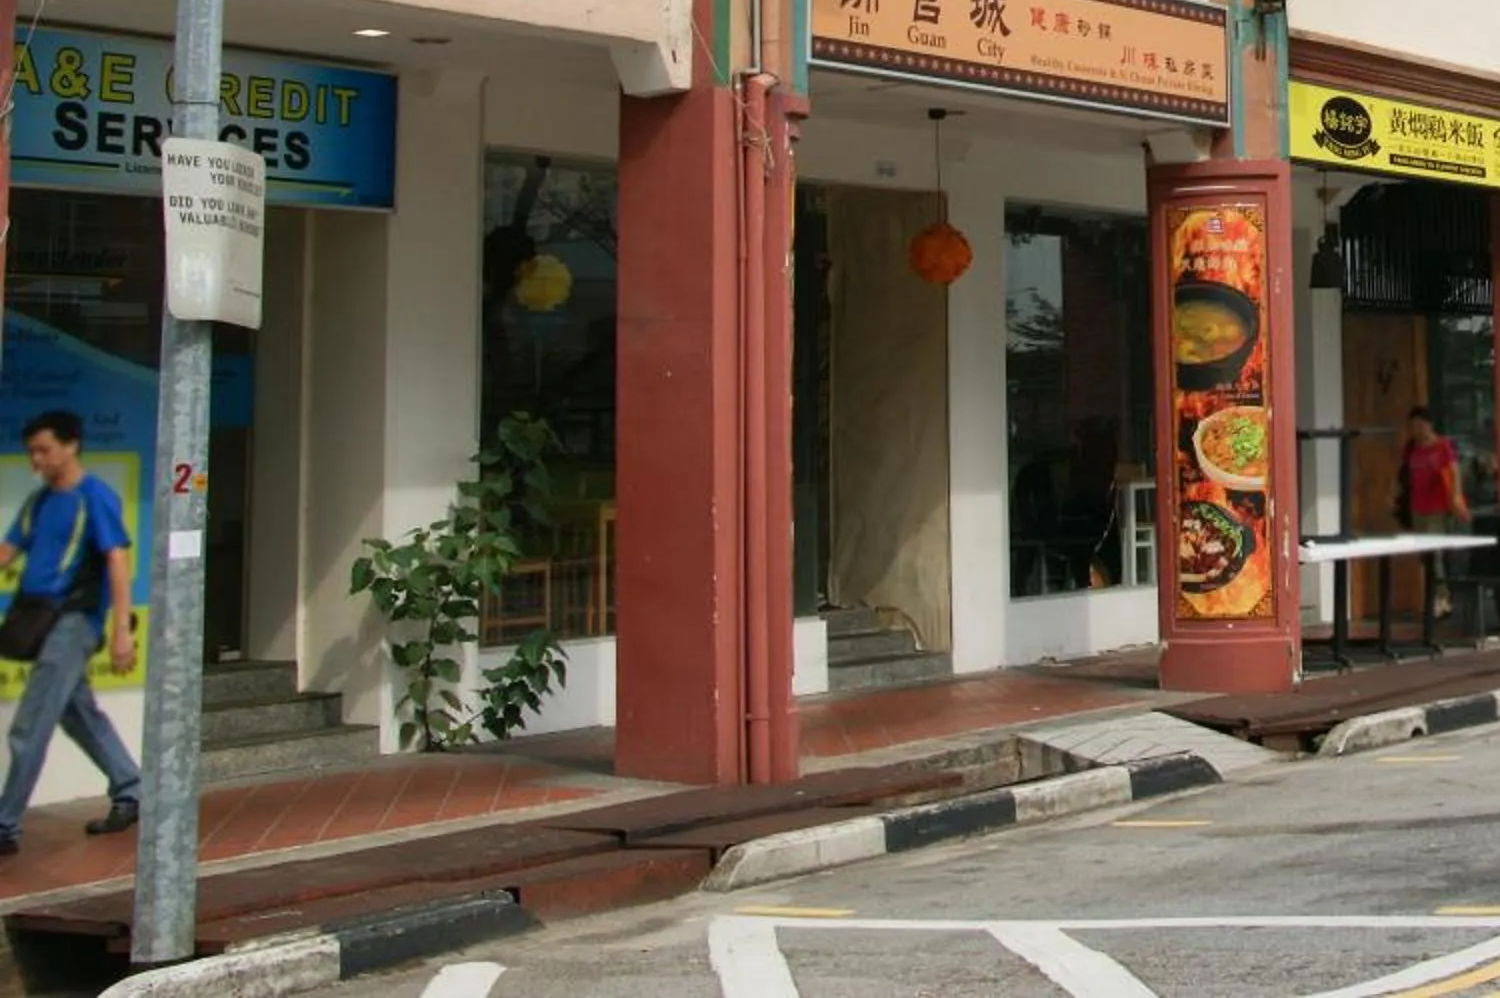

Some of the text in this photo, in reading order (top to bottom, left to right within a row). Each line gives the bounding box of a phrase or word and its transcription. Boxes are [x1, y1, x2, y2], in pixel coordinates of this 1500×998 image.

[848, 15, 1006, 63] Jin Guan City
[166, 64, 359, 126] REDIT
[52, 102, 311, 171] SERCES
[167, 154, 200, 167] HAVE
[208, 157, 230, 171] YOU
[169, 195, 193, 208] DID
[201, 197, 224, 211] YOU
